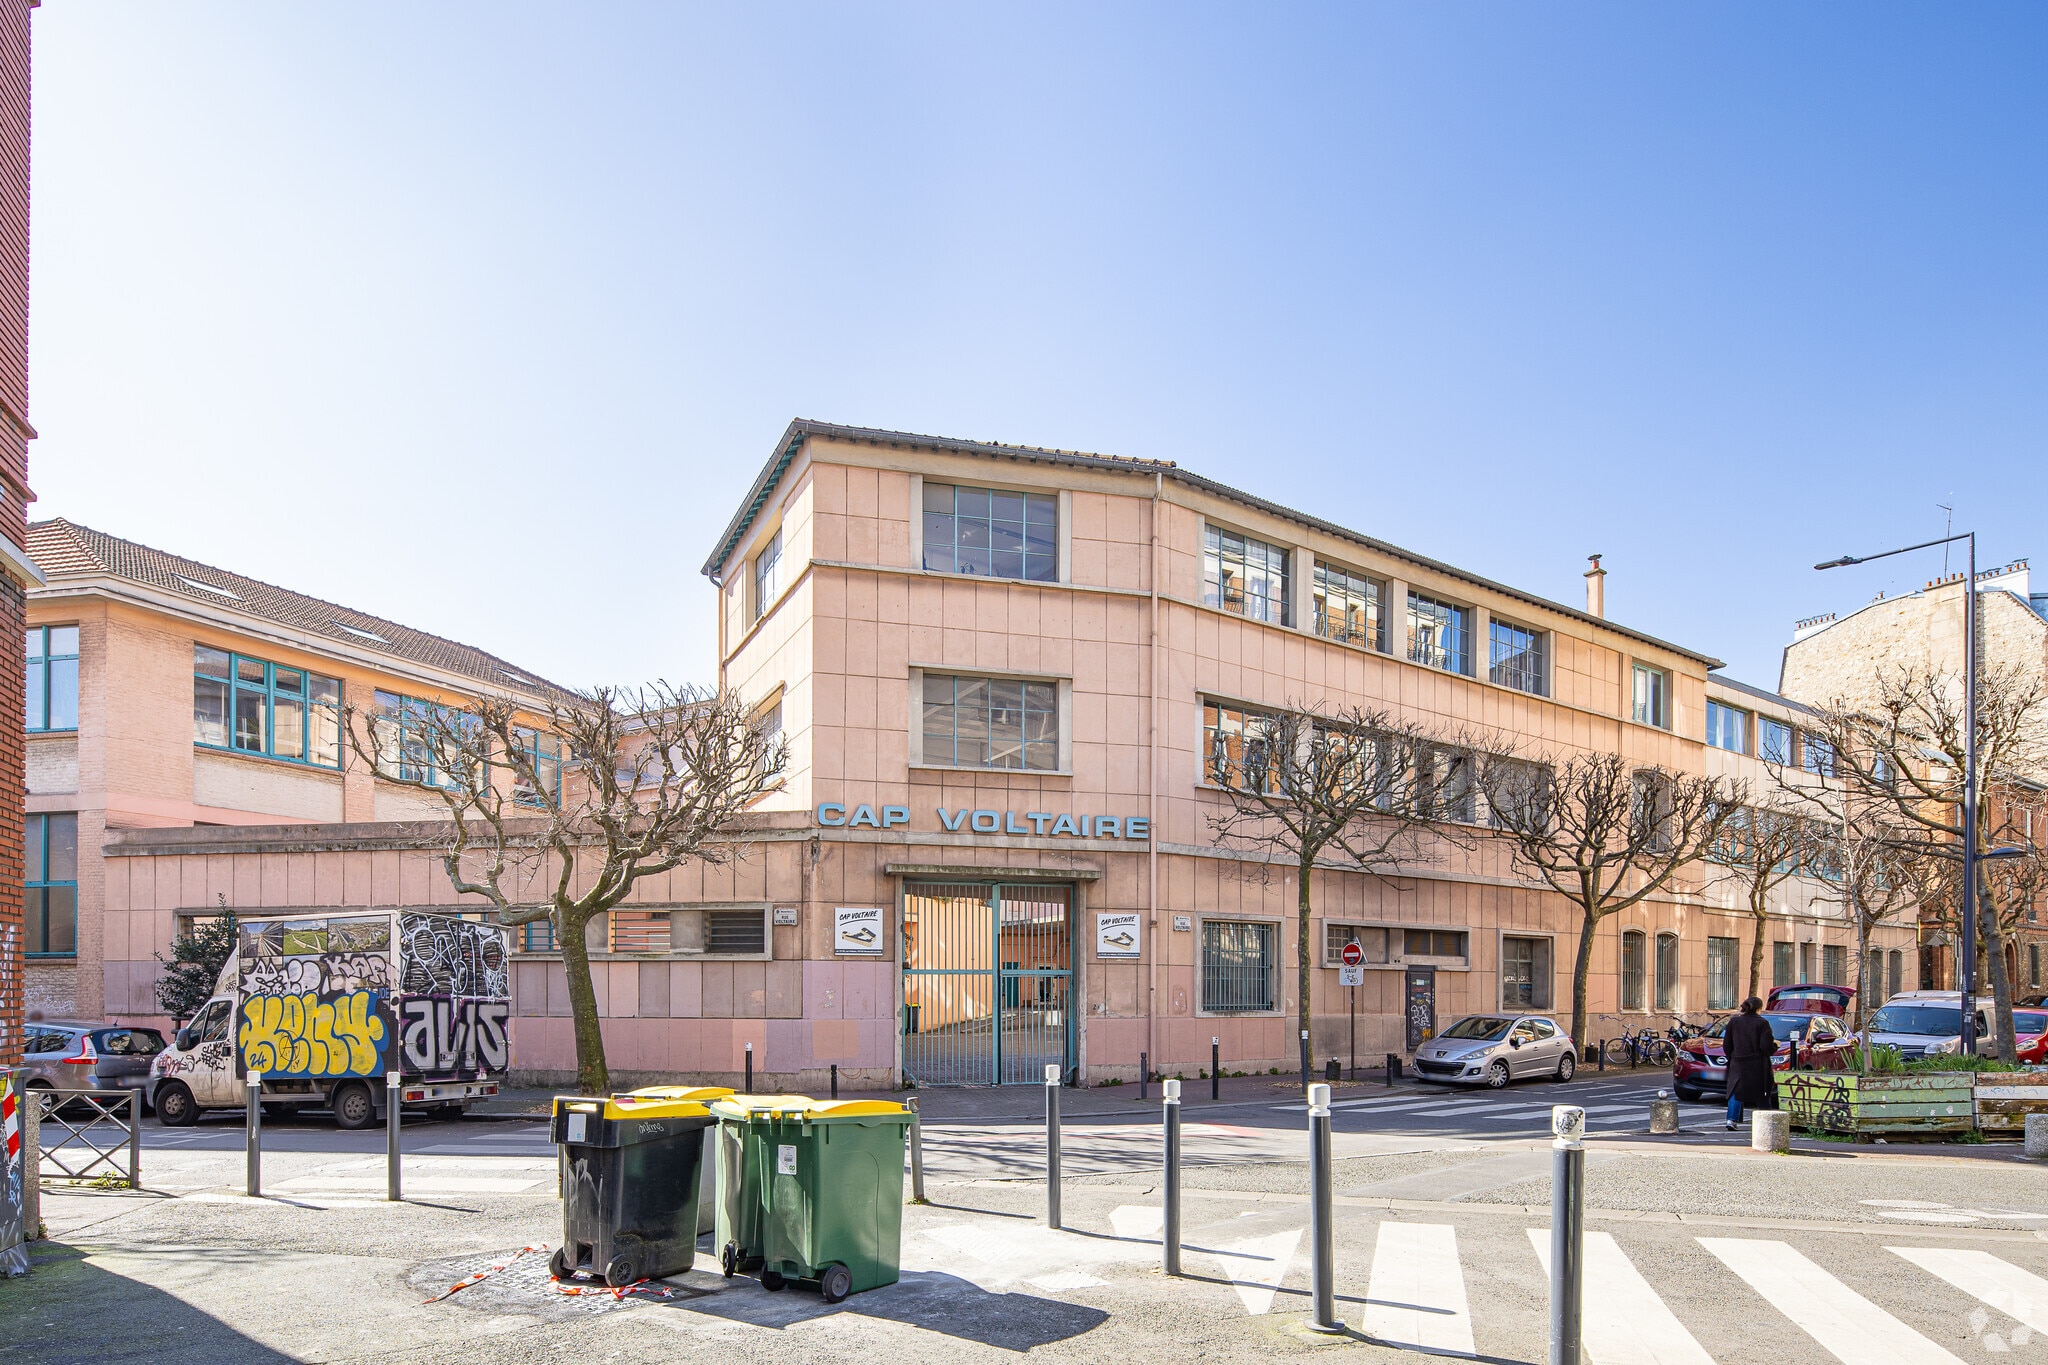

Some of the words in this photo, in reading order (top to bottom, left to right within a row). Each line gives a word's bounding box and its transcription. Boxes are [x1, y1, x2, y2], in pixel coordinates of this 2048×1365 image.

[817, 803, 910, 828] CAP
[937, 808, 1149, 839] VOLTAIRE
[852, 910, 878, 919] VOLTAIRE
[1112, 916, 1136, 925] VOLTAIRE
